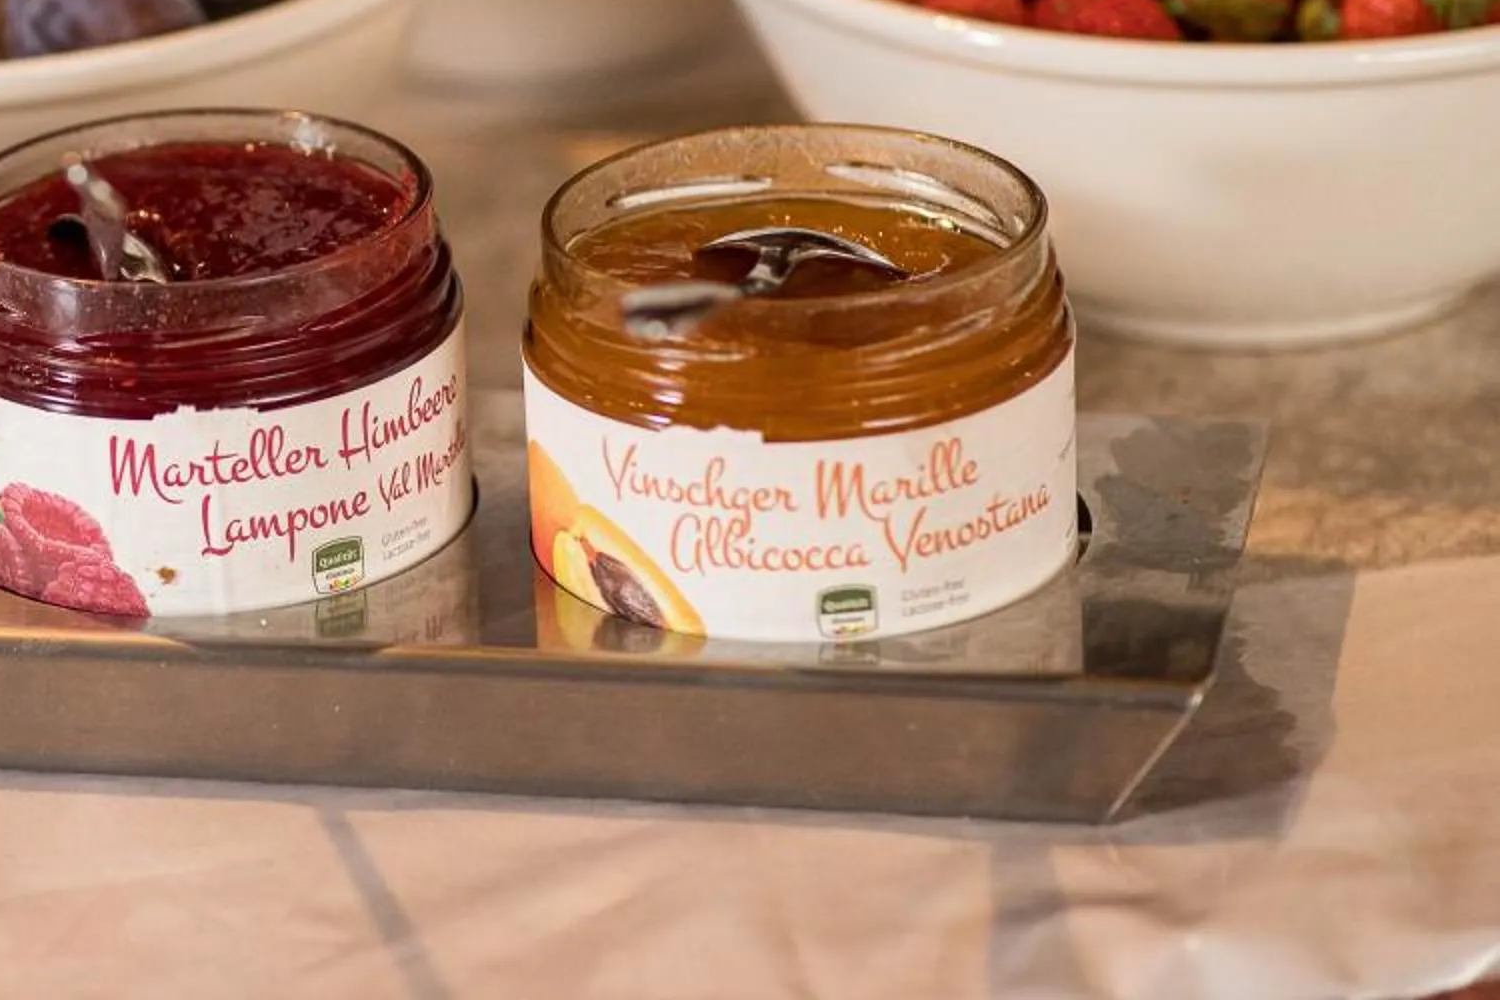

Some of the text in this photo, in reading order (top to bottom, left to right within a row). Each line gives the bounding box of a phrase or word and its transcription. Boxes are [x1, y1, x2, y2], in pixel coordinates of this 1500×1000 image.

[108, 424, 327, 505] Marteller
[200, 489, 371, 563] Lampone
[377, 460, 412, 513] Val
[601, 436, 979, 540] Vinschger Marille
[669, 483, 1053, 577] Albicocca Venostana
